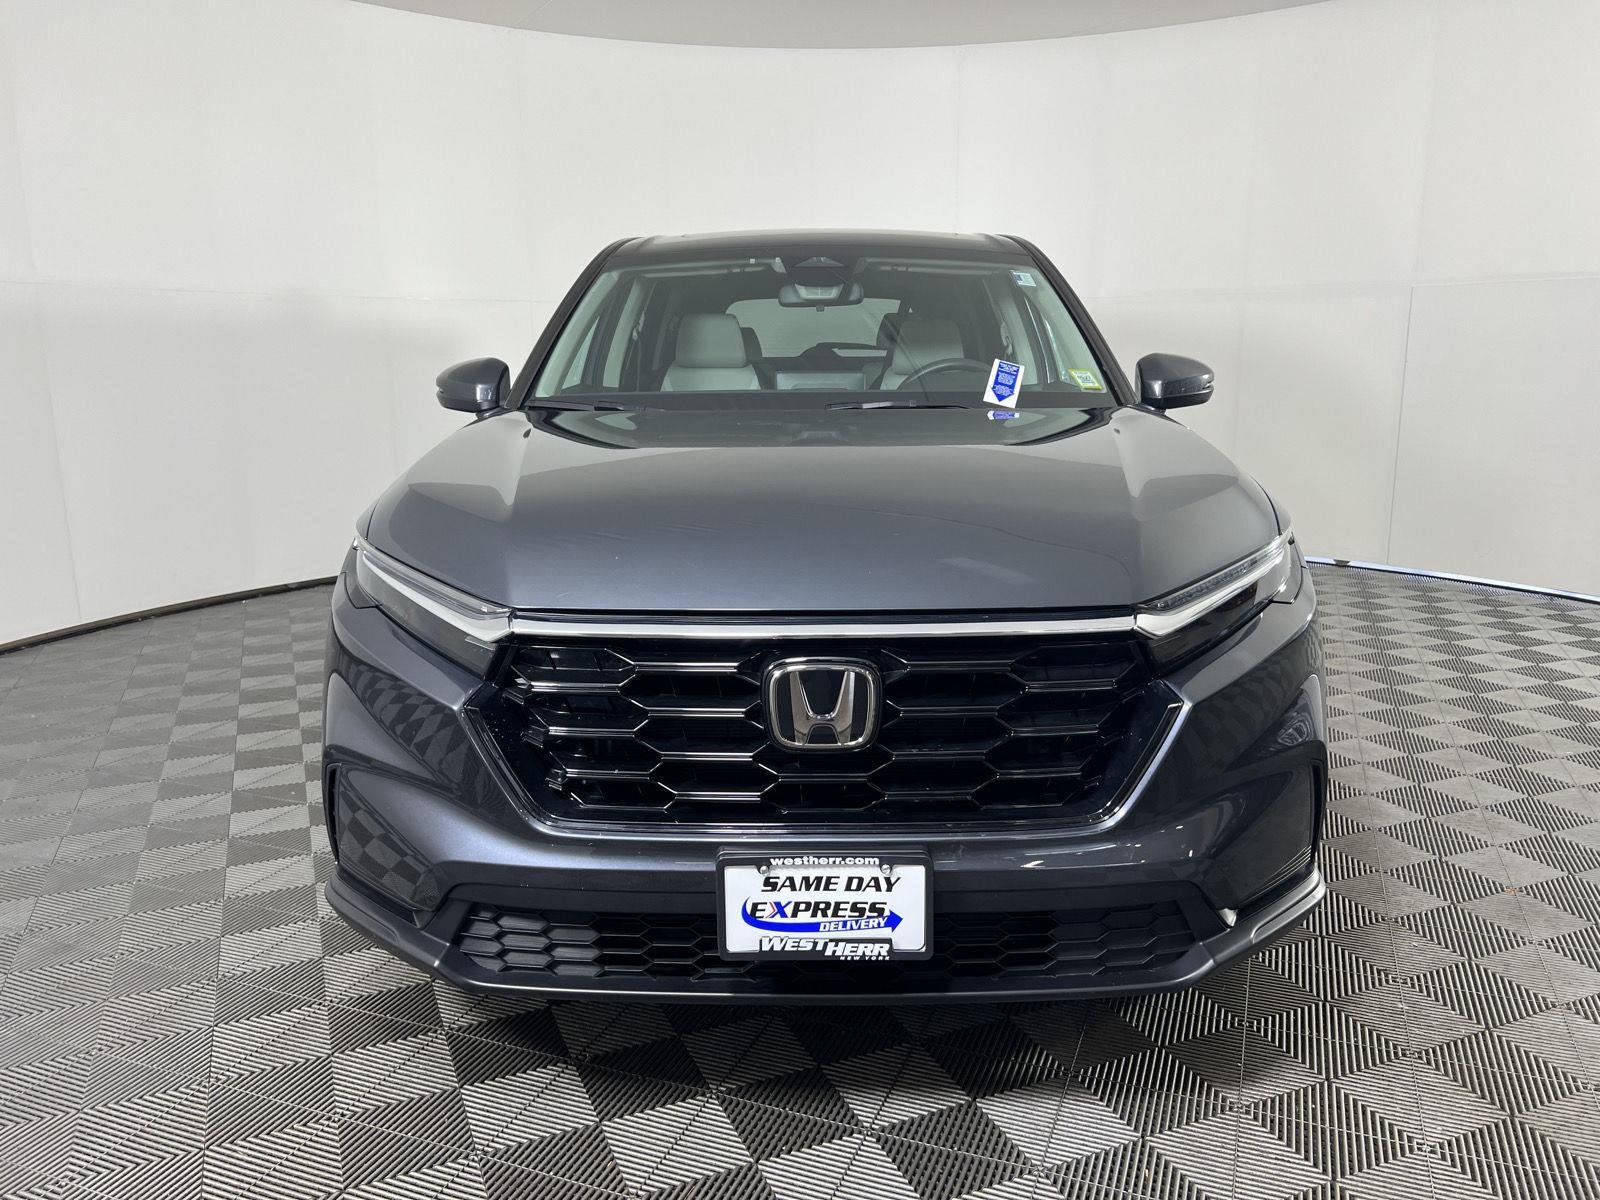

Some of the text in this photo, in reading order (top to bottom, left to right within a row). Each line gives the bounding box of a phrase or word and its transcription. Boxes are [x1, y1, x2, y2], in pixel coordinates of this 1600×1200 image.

[769, 856, 880, 865] westherr.com
[761, 876, 901, 893] SAME DAY
[750, 901, 887, 918] EXPRESS
[819, 917, 888, 932] DELIVERY
